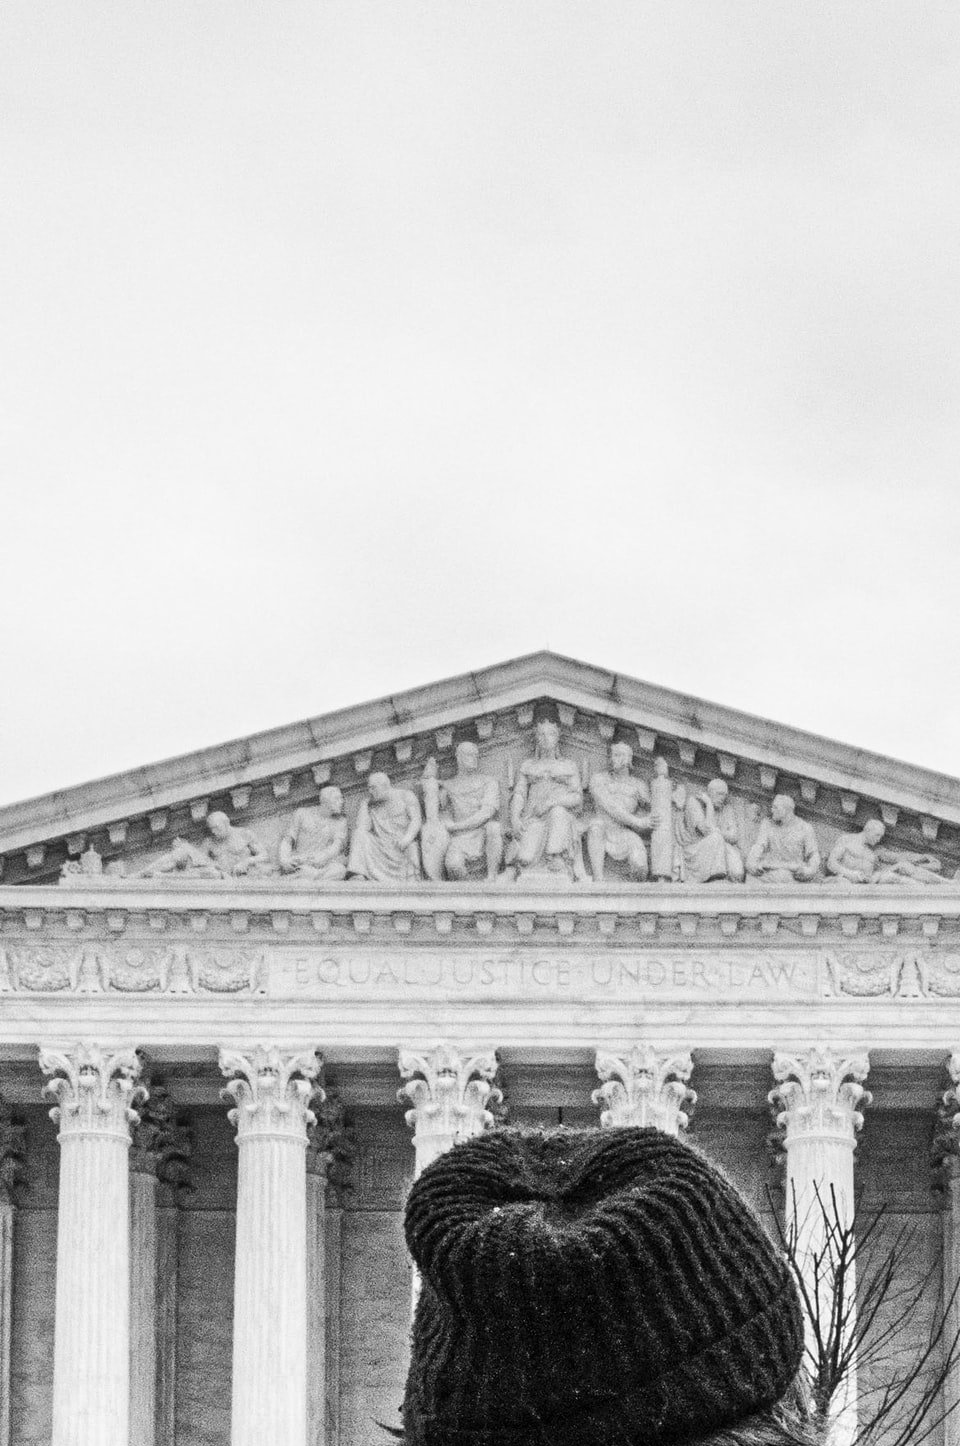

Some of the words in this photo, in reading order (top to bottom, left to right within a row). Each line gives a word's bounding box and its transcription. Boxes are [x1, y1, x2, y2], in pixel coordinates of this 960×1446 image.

[295, 958, 419, 986] EQUAL
[430, 959, 570, 985] JUSTICE
[591, 960, 712, 986] UNDER
[724, 960, 800, 986] LAW
